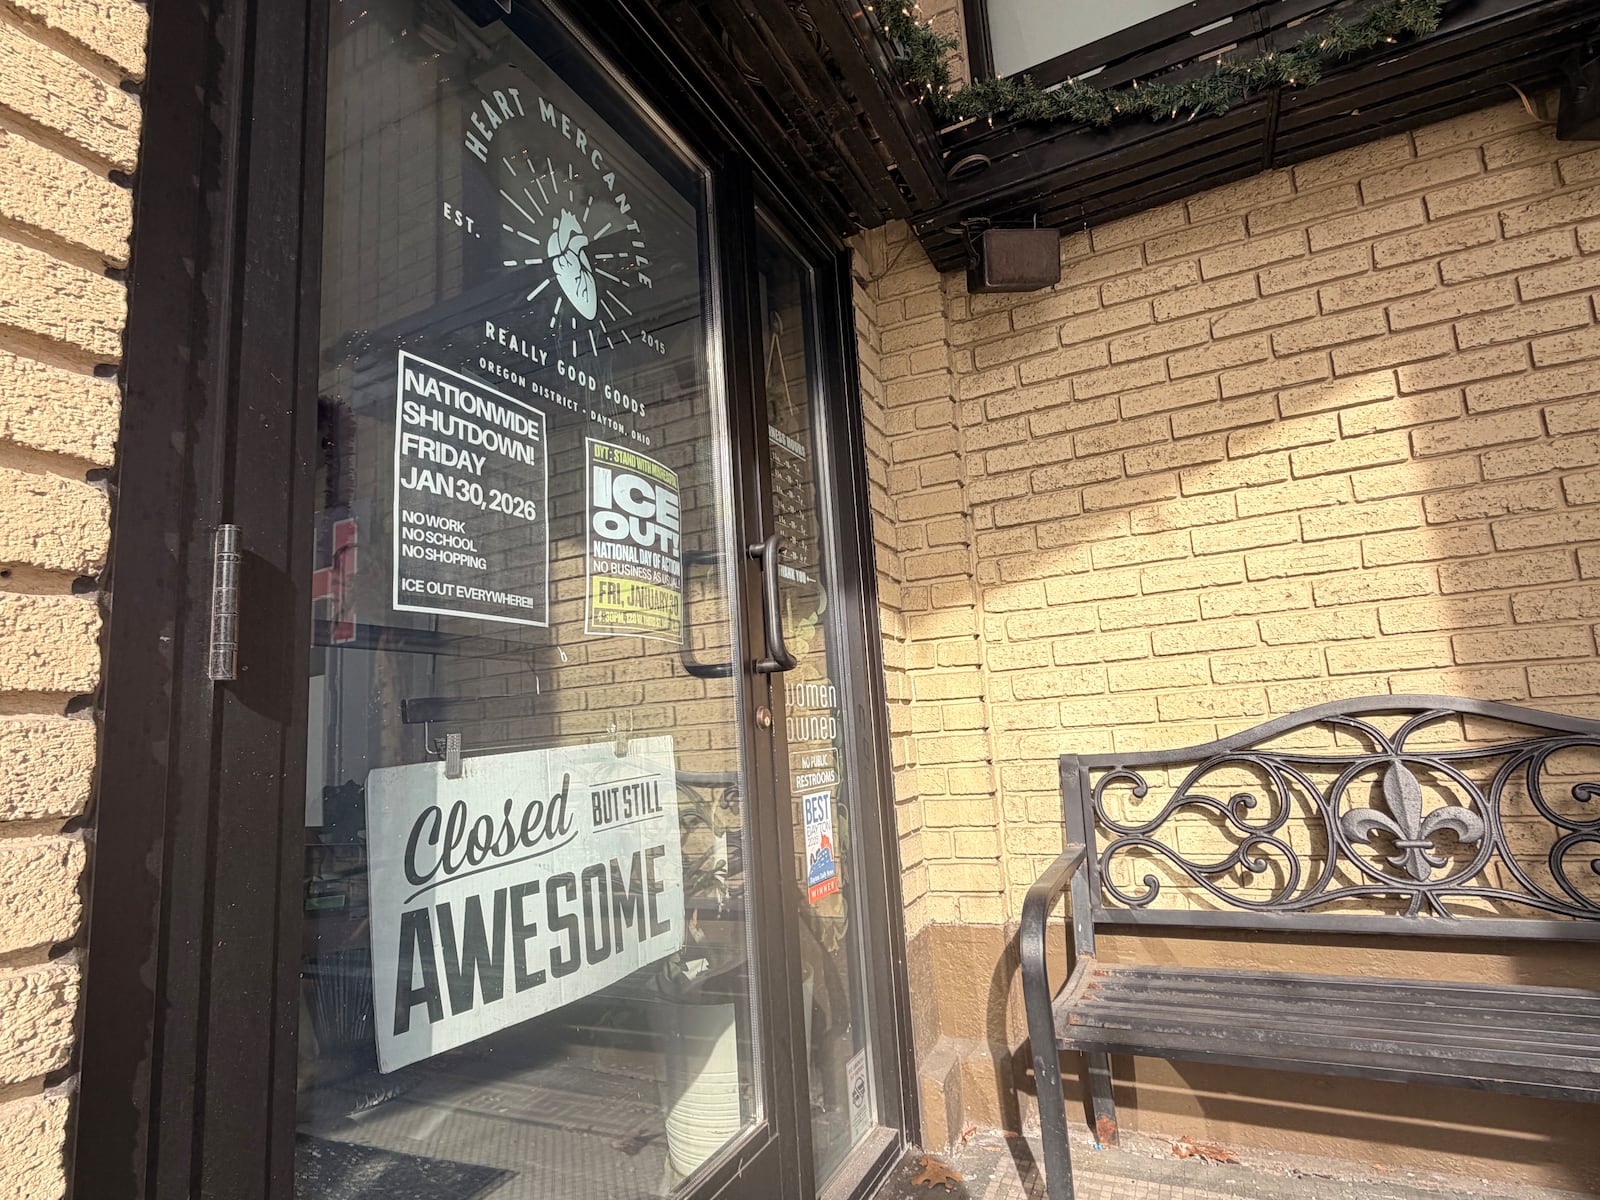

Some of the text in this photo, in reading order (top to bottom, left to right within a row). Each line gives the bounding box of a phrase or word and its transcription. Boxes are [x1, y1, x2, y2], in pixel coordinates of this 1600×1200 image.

[465, 88, 652, 288] HEART MERCANTILE
[443, 202, 481, 239] EST.
[641, 330, 665, 354] 2015
[485, 321, 646, 417] REALLY GOOD GOODS
[404, 368, 540, 441] NATIONWIDE
[479, 357, 650, 446] OREGON DISTRICT DAYTON, OHIO
[403, 401, 535, 466] SHUTDOWN!
[402, 432, 486, 476] FRIDAY
[613, 449, 636, 467] STAND
[636, 456, 652, 474] WITH
[400, 466, 536, 521] JAN 30, 2026
[593, 465, 679, 532] ICE
[402, 509, 466, 534] NO WORK
[402, 526, 477, 552] NO SCHOOL
[592, 510, 680, 558] OUT!
[402, 544, 487, 570] NO SHOPPING
[593, 540, 638, 563] NATIONAL
[639, 549, 652, 567] DAY
[653, 552, 661, 570] OF
[593, 560, 609, 573] NO
[610, 562, 652, 580] BUSINESS
[652, 571, 661, 582] AS
[401, 578, 424, 593] ICE
[426, 581, 455, 596] OUT
[599, 581, 679, 616] FRI, JANUARY 30
[796, 770, 835, 789] RESTROOMS
[801, 754, 828, 769] NO PUBLIC
[591, 780, 663, 827] BUT STILL
[805, 794, 829, 825] BEST
[403, 772, 574, 886] Closed
[806, 821, 831, 837] DAYTON
[393, 844, 671, 1037] AWESOME
